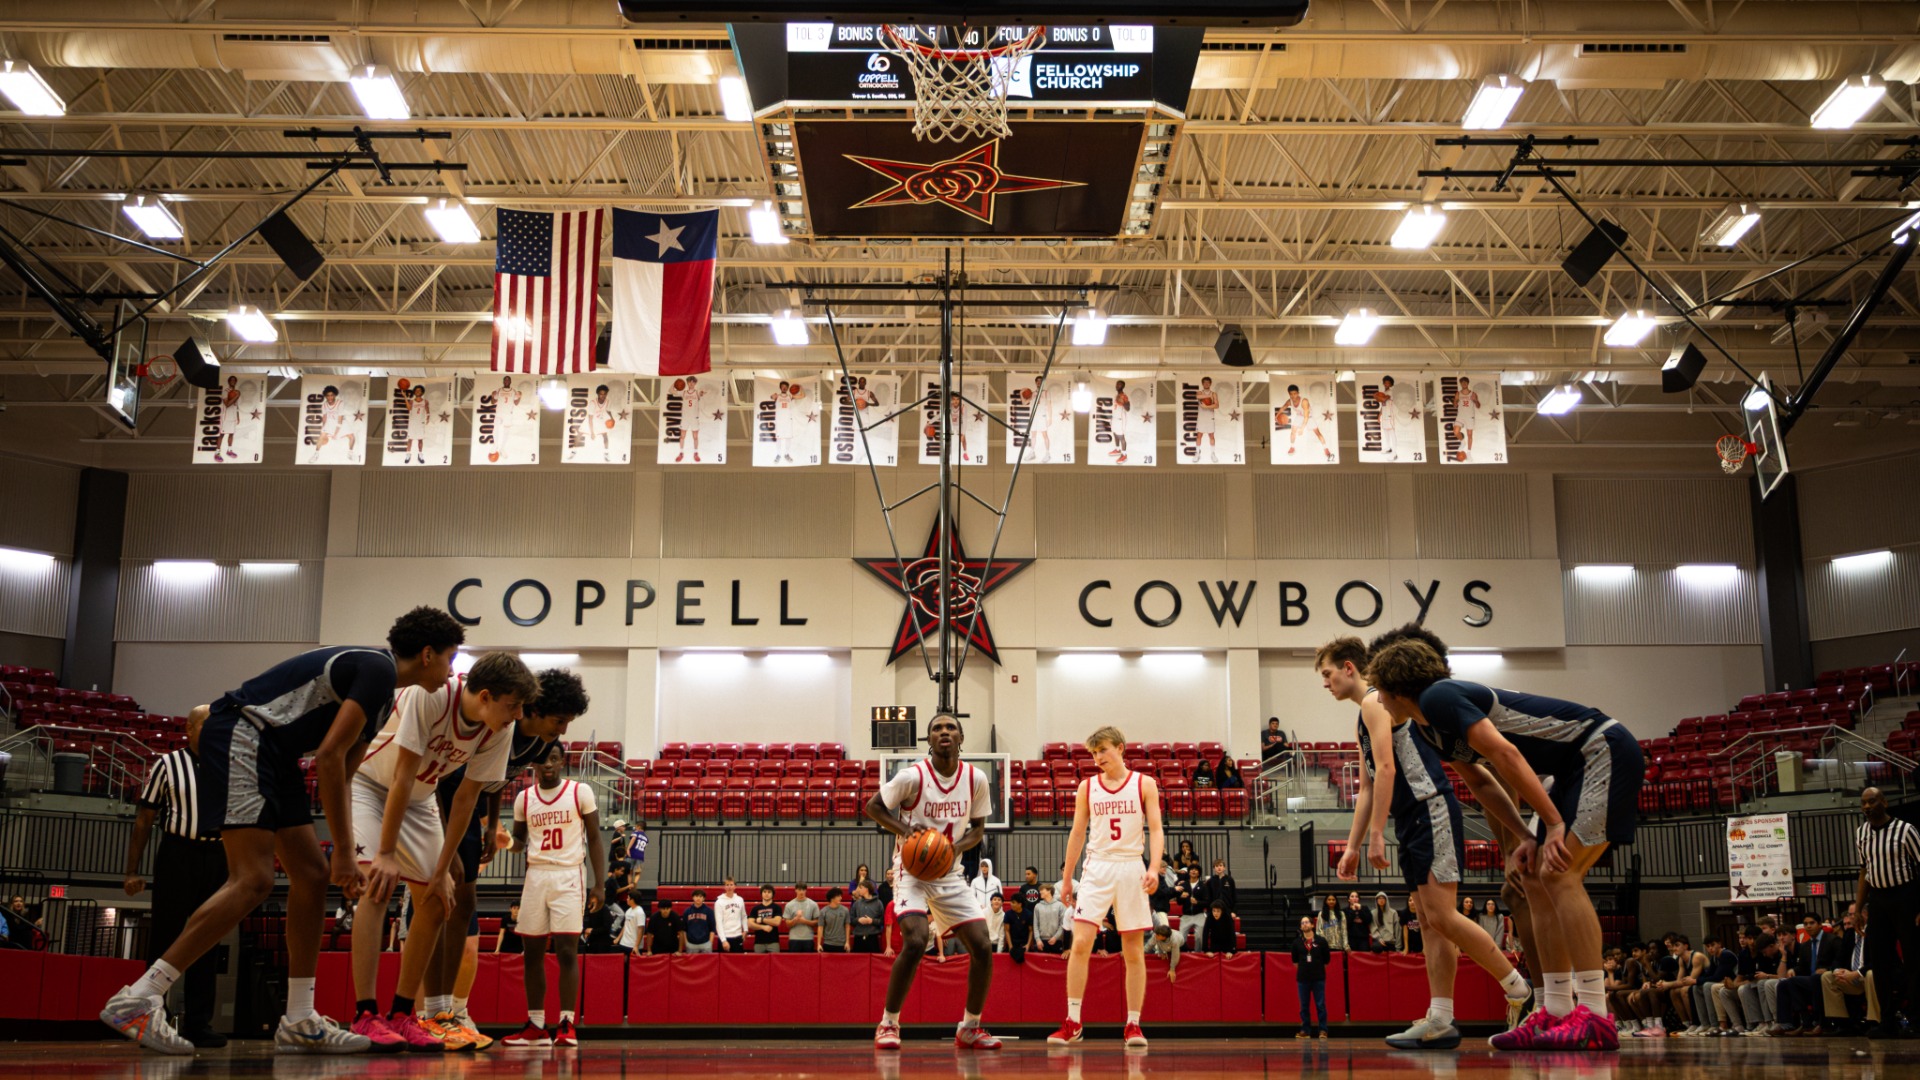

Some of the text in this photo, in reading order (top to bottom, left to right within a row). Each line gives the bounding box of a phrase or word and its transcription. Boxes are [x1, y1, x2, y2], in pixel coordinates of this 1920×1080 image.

[838, 27, 873, 41] BONUS
[1053, 28, 1100, 41] BONUS 0
[1036, 64, 1139, 77] FELLOWSHIP
[858, 73, 899, 83] COPPELL
[1036, 76, 1102, 89] CHURCH
[477, 395, 497, 444] socks
[976, 455, 983, 463] 12
[1063, 454, 1070, 462] 15
[1144, 455, 1152, 463] 20
[1233, 453, 1241, 462] 21
[1413, 452, 1422, 460] 23
[1494, 453, 1503, 461] 32
[447, 578, 1493, 628] COPPELL COWBOYS
[1093, 800, 1137, 816] COPPELL
[531, 810, 572, 828] COPPELL
[1754, 817, 1784, 825] SPONSORS
[1109, 818, 1122, 841] 5
[540, 828, 563, 851] 20
